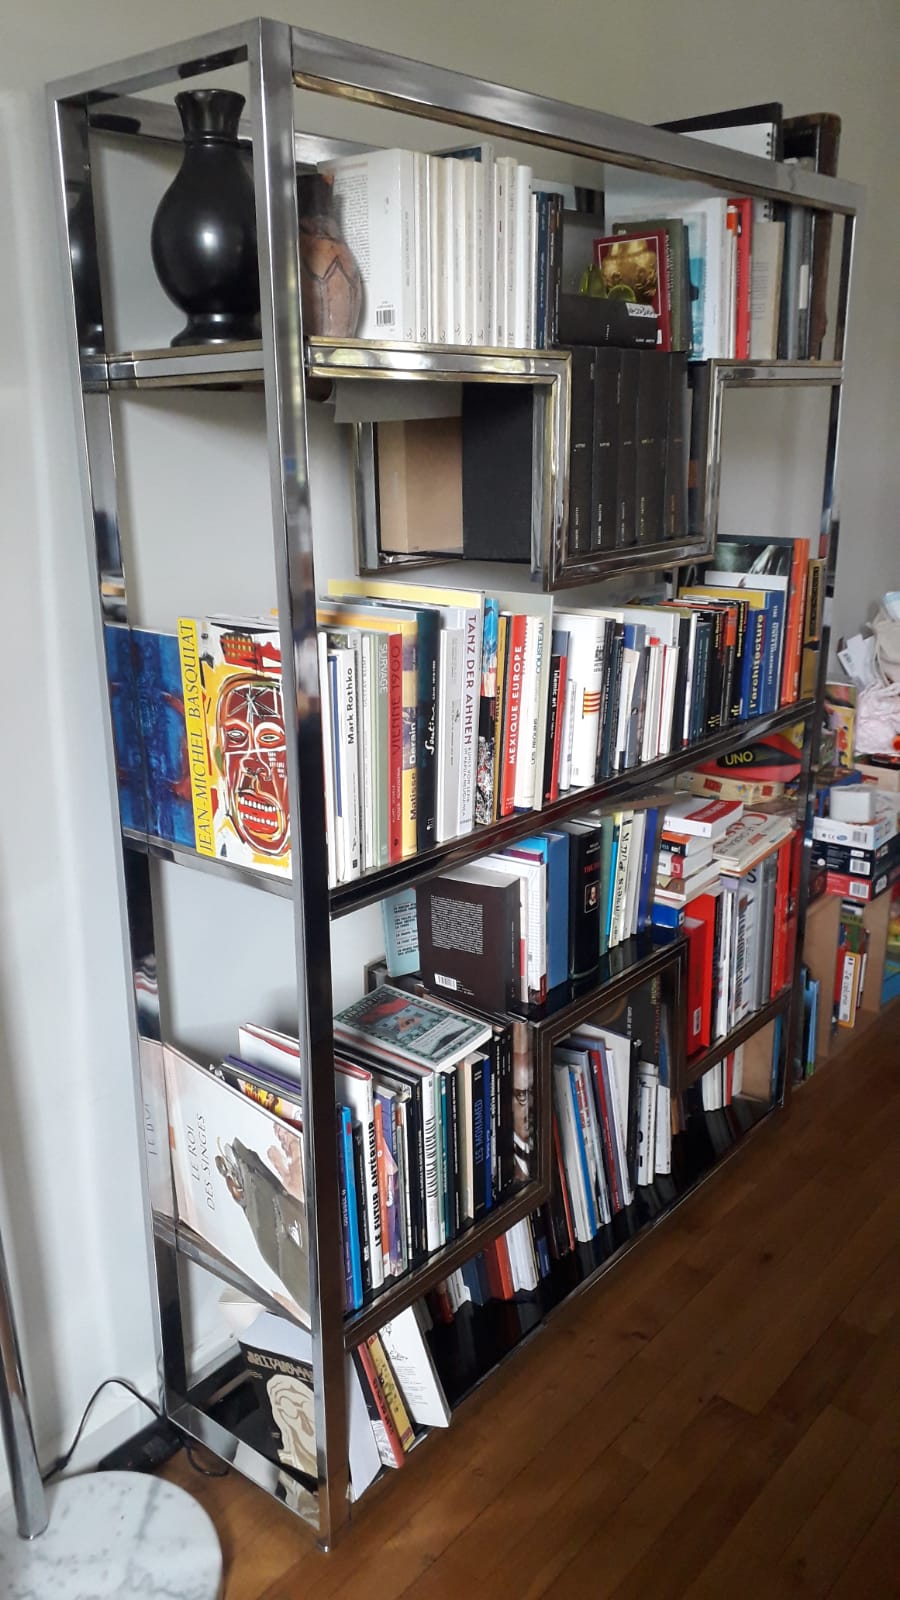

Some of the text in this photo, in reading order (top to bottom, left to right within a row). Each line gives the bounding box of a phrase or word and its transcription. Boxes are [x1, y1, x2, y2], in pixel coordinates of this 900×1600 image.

[379, 643, 388, 694] SURVAGE
[463, 615, 477, 744] TANZ DER AHNEN
[535, 622, 545, 674] COUSTEAU
[552, 670, 560, 696] Islamic
[750, 614, 764, 708] l'architecture
[180, 620, 212, 851] JEAN-MICHEL BASQUIAT
[346, 668, 355, 745] Mark Rothko
[390, 645, 401, 757] VIENNE 1900
[408, 722, 417, 820] Matisse Derain
[724, 750, 754, 766] UNO
[187, 1124, 199, 1180] LE ROI
[197, 1115, 215, 1210] DES SINGES
[474, 1099, 484, 1164] LES MOHAMED
[368, 1120, 382, 1247] LE FUTUR ANTÉRIEUR
